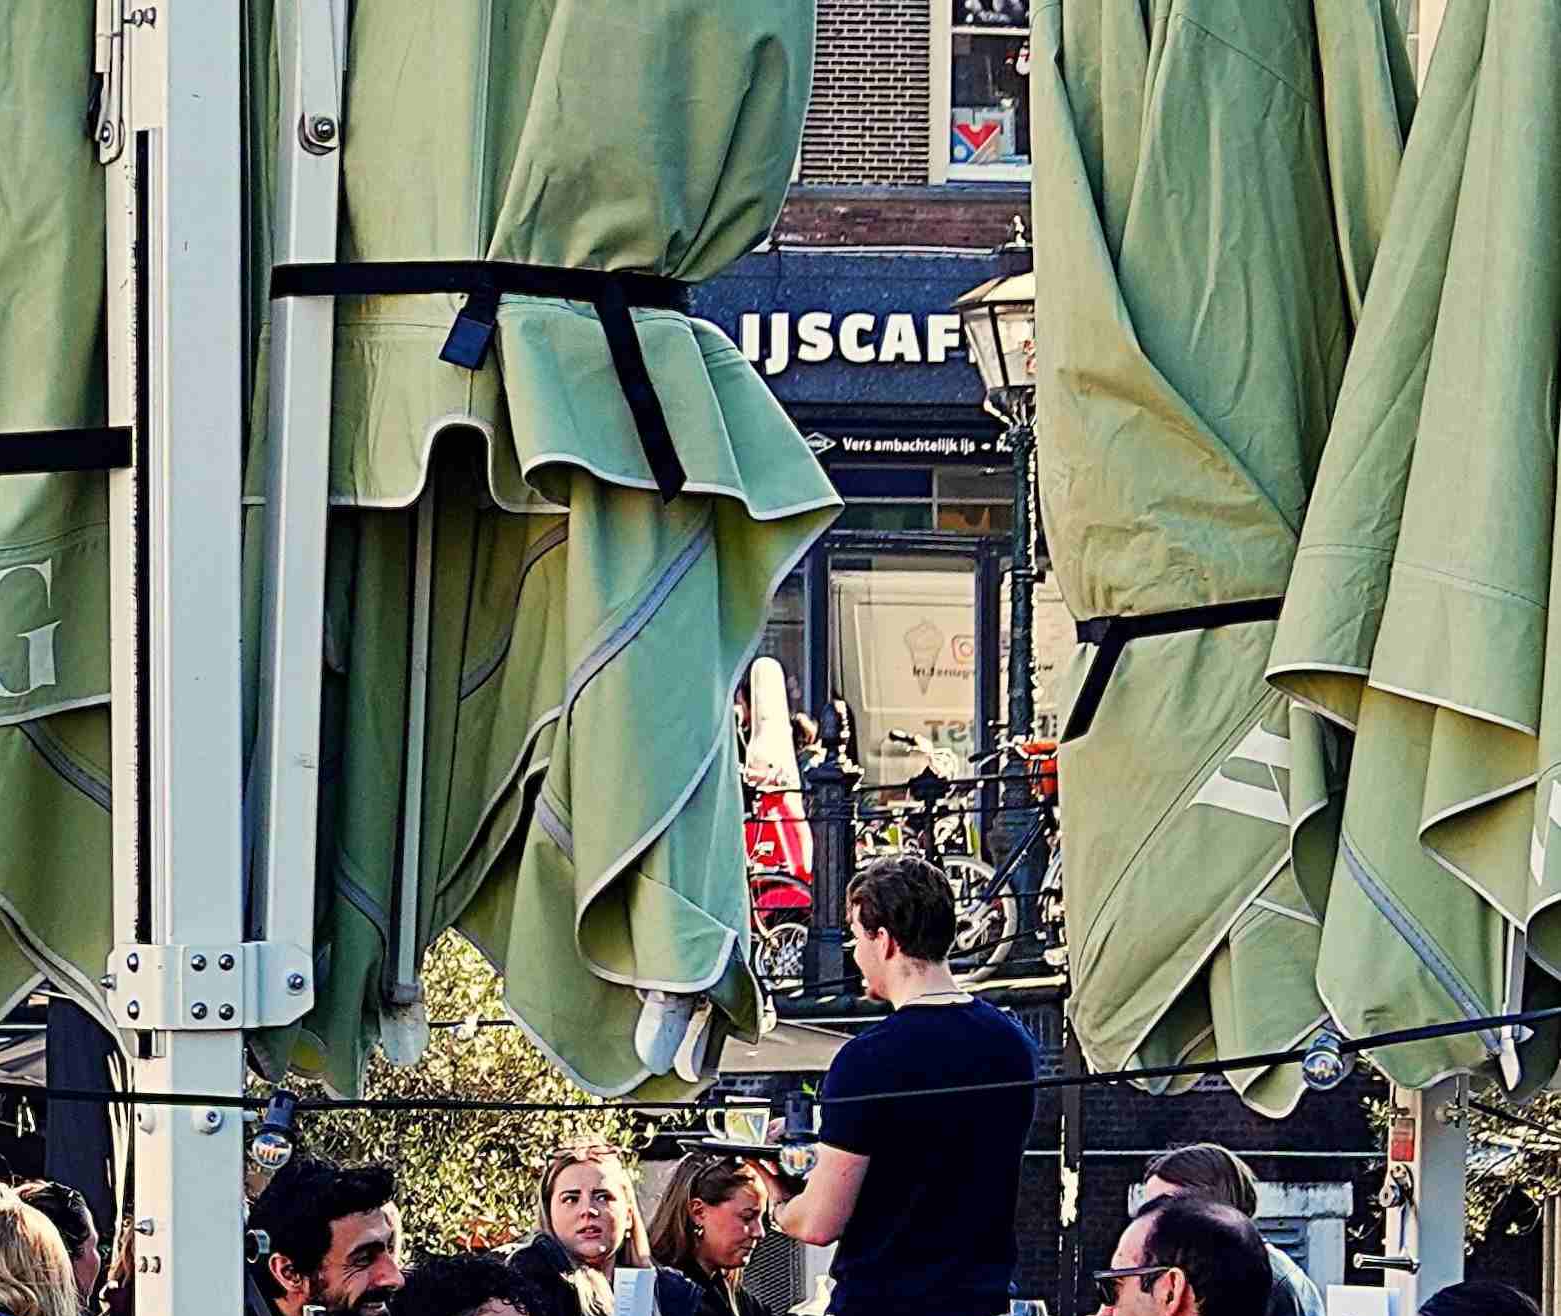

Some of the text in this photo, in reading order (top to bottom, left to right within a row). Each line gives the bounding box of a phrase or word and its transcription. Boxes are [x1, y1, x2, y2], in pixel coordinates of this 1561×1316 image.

[740, 311, 978, 376] IJSCAF
[842, 436, 871, 451] Vers
[874, 437, 958, 456] ambachtelijk
